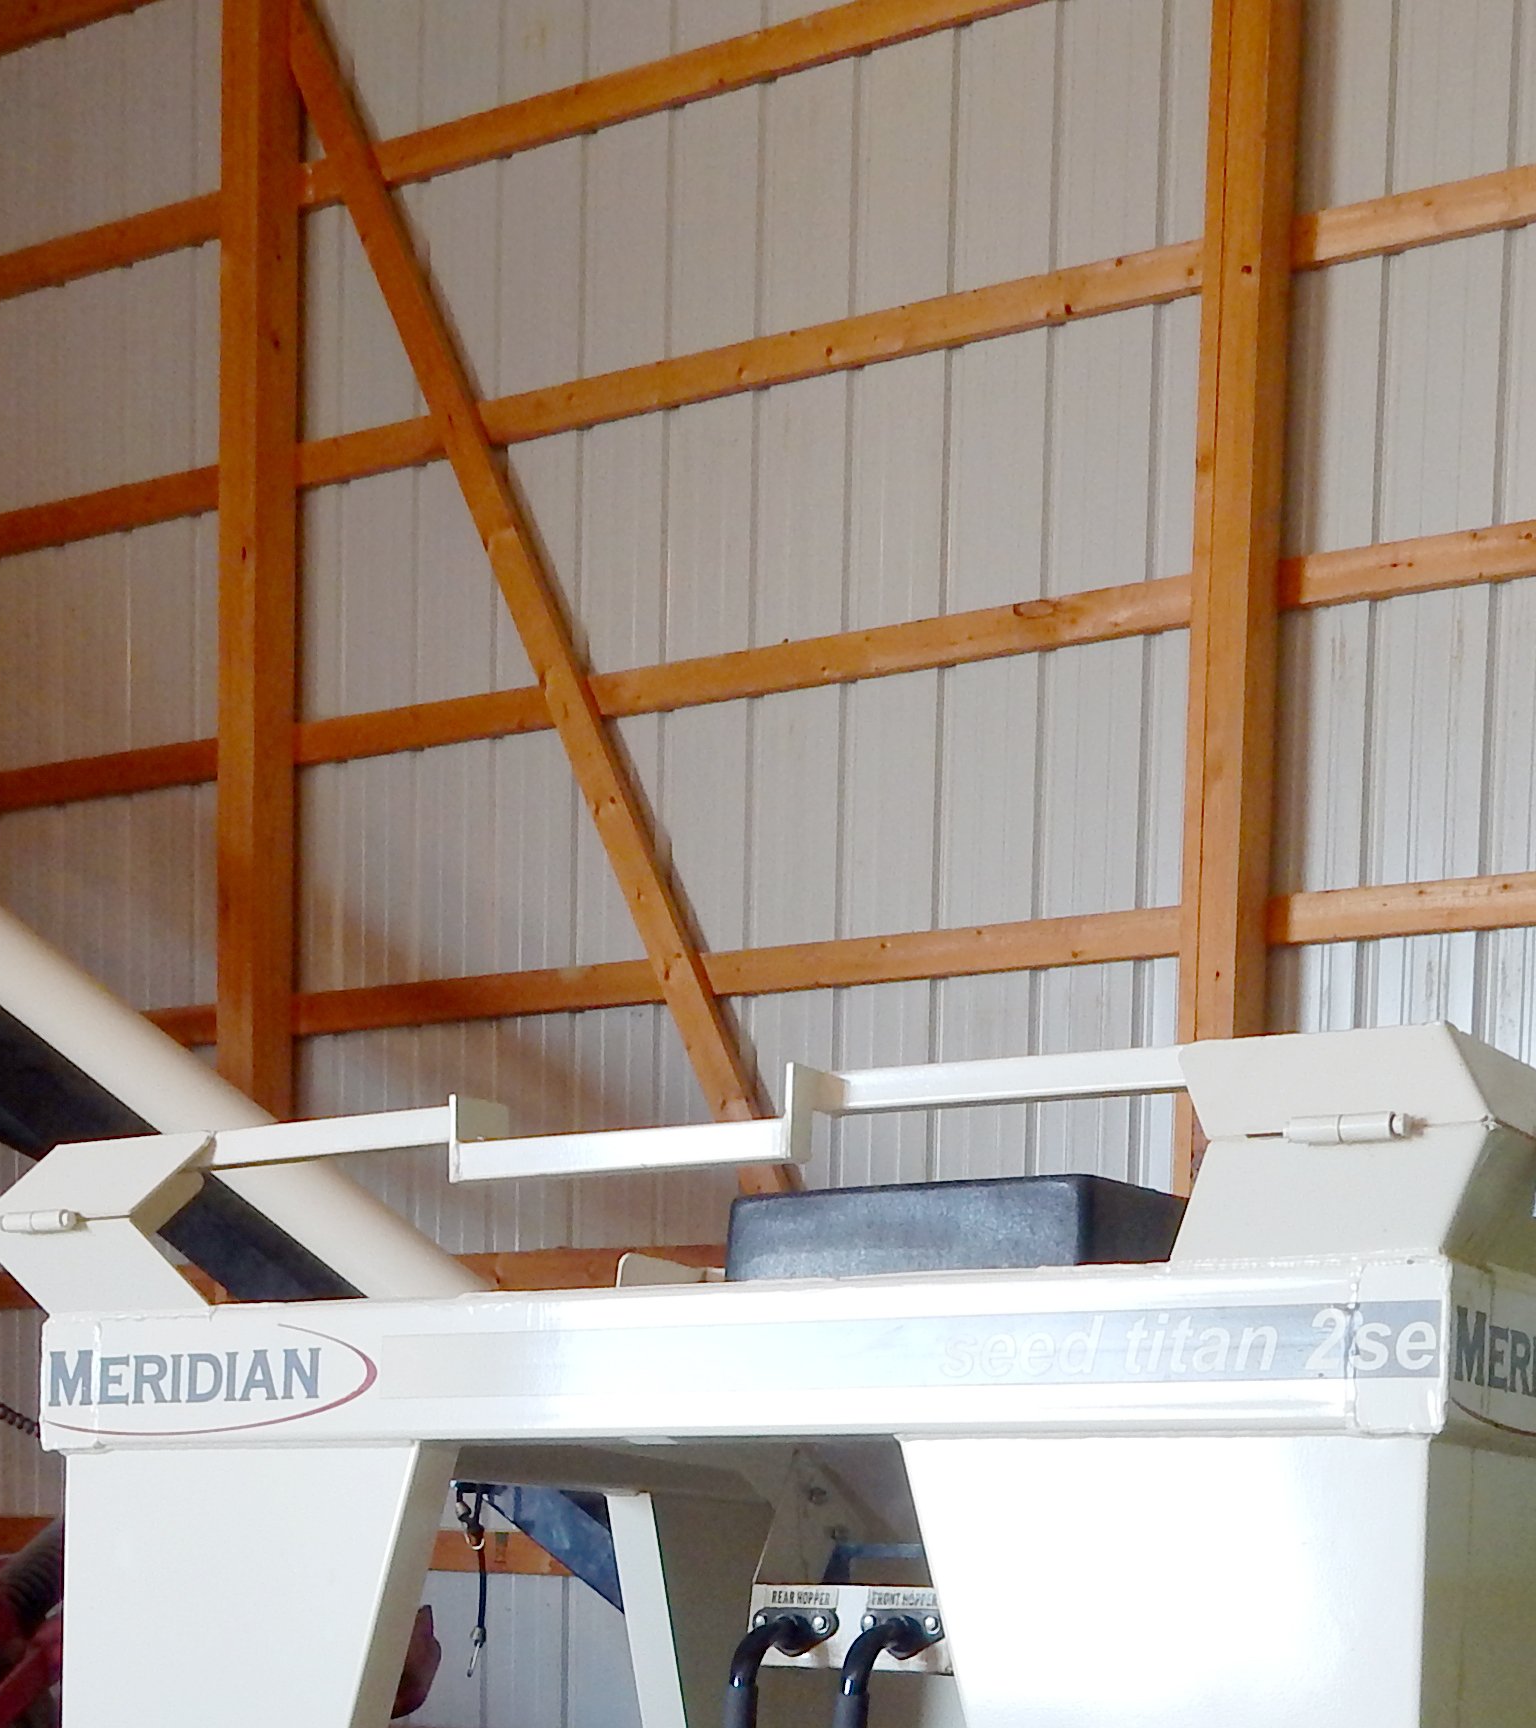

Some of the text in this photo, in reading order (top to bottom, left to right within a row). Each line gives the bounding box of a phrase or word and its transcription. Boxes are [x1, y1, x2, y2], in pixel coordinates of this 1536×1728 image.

[939, 1315, 1103, 1378] seed
[1123, 1312, 1278, 1374] titan
[48, 1347, 321, 1406] MERIDIAN
[771, 1590, 831, 1606] REAR HOPPER
